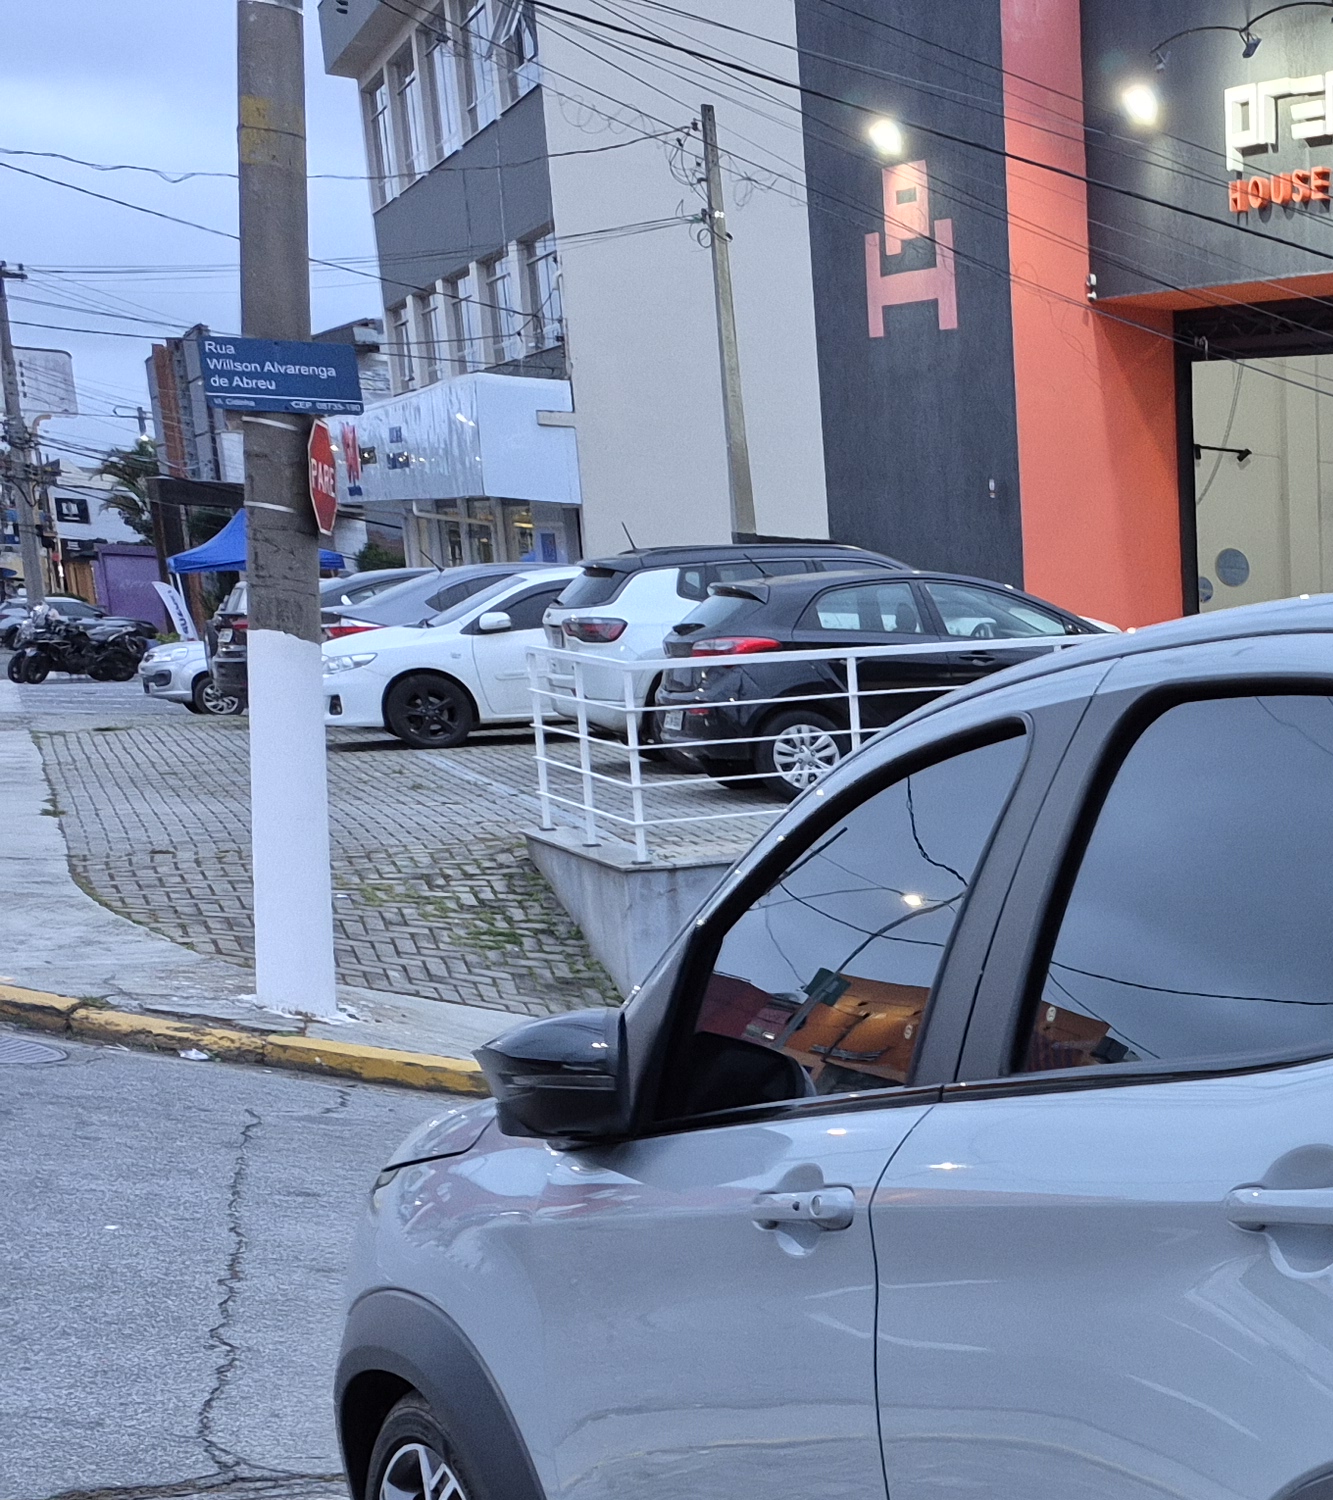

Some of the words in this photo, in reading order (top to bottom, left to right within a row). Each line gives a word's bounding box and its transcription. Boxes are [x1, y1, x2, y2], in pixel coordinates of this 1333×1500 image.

[1229, 166, 1331, 212] HOUSE
[204, 341, 236, 354] Rua
[206, 358, 261, 373] Willson
[264, 362, 337, 379] Alvarenga
[210, 374, 229, 387] de
[232, 376, 277, 390] Abreu
[290, 400, 313, 409] CEP
[310, 457, 336, 498] PARE
